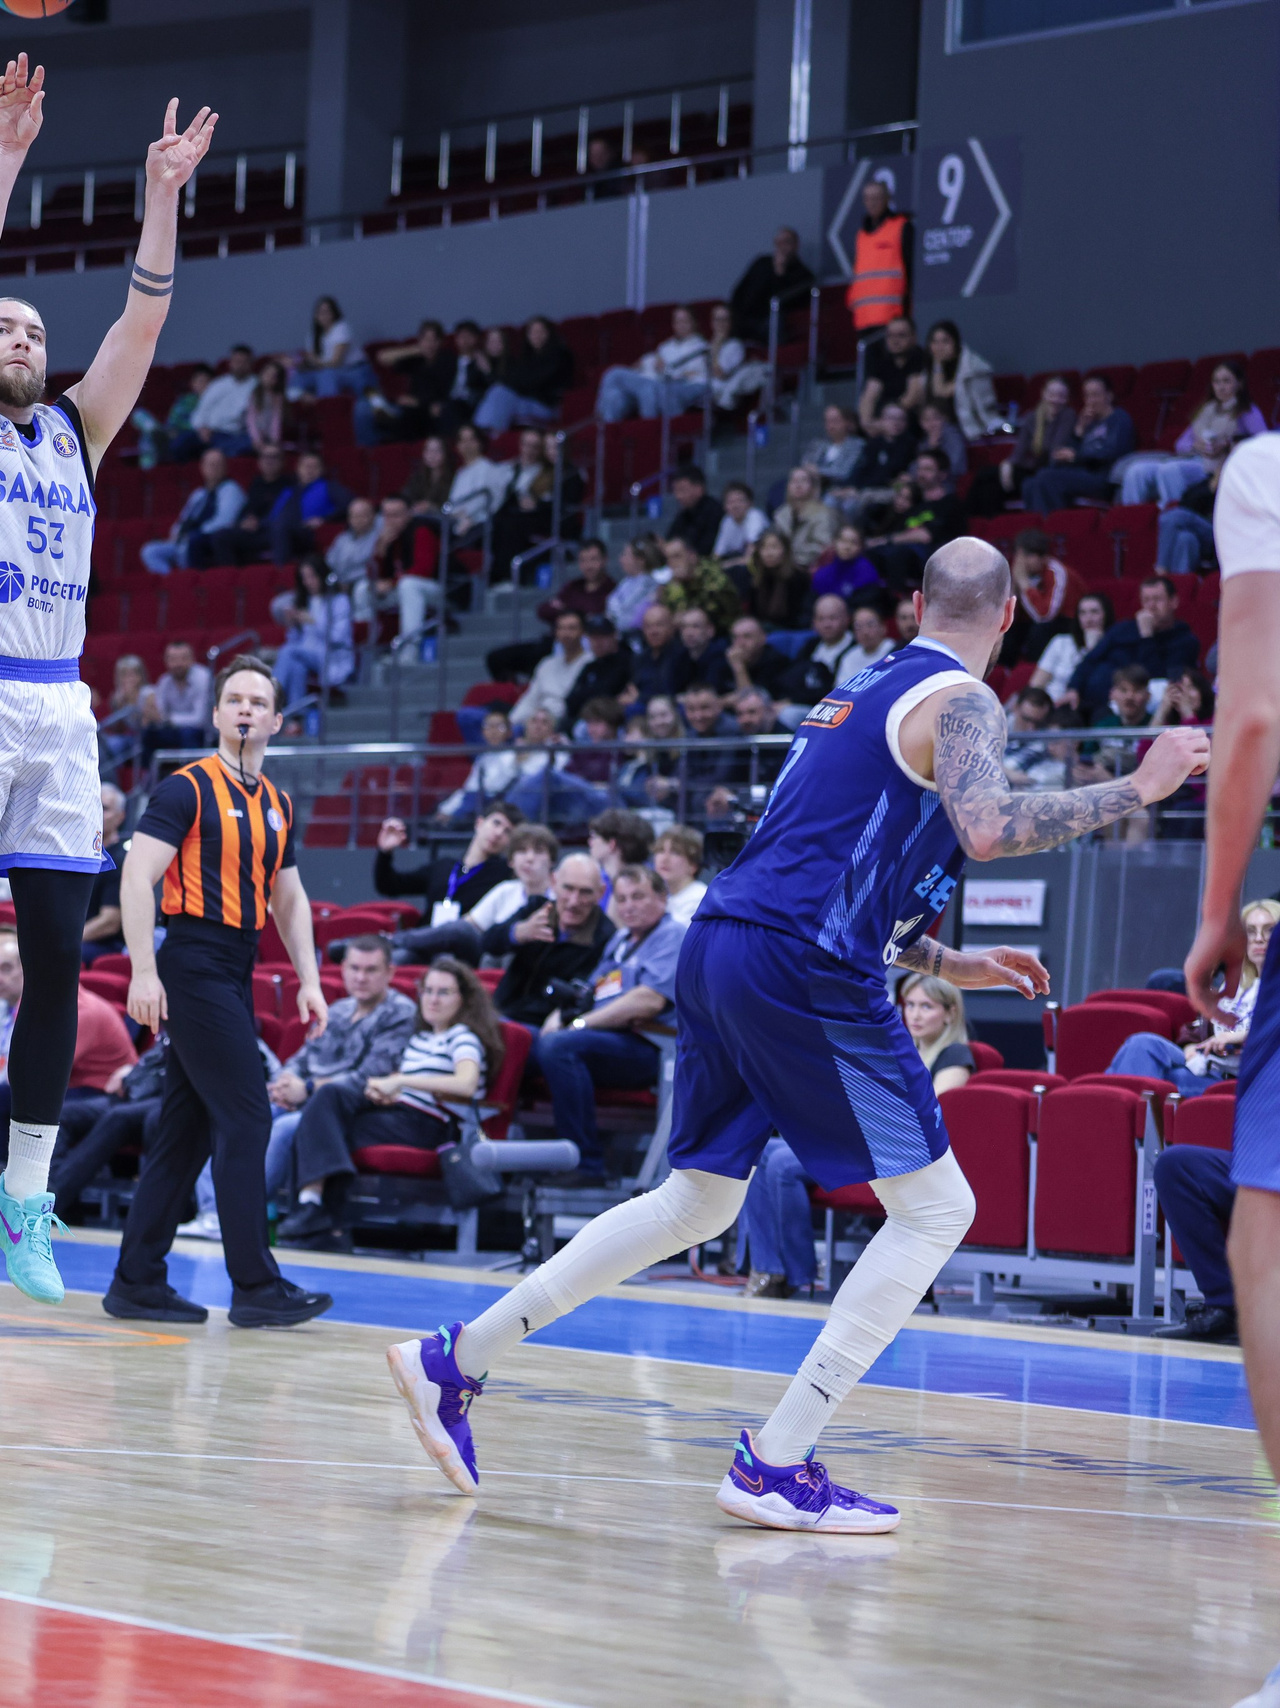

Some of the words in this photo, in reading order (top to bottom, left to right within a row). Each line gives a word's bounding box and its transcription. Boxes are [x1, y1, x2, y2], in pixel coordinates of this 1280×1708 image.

[938, 154, 965, 225] 9
[26, 515, 65, 560] 53
[27, 596, 54, 614] ВОЛГА
[31, 574, 86, 603] РОСЕТИ
